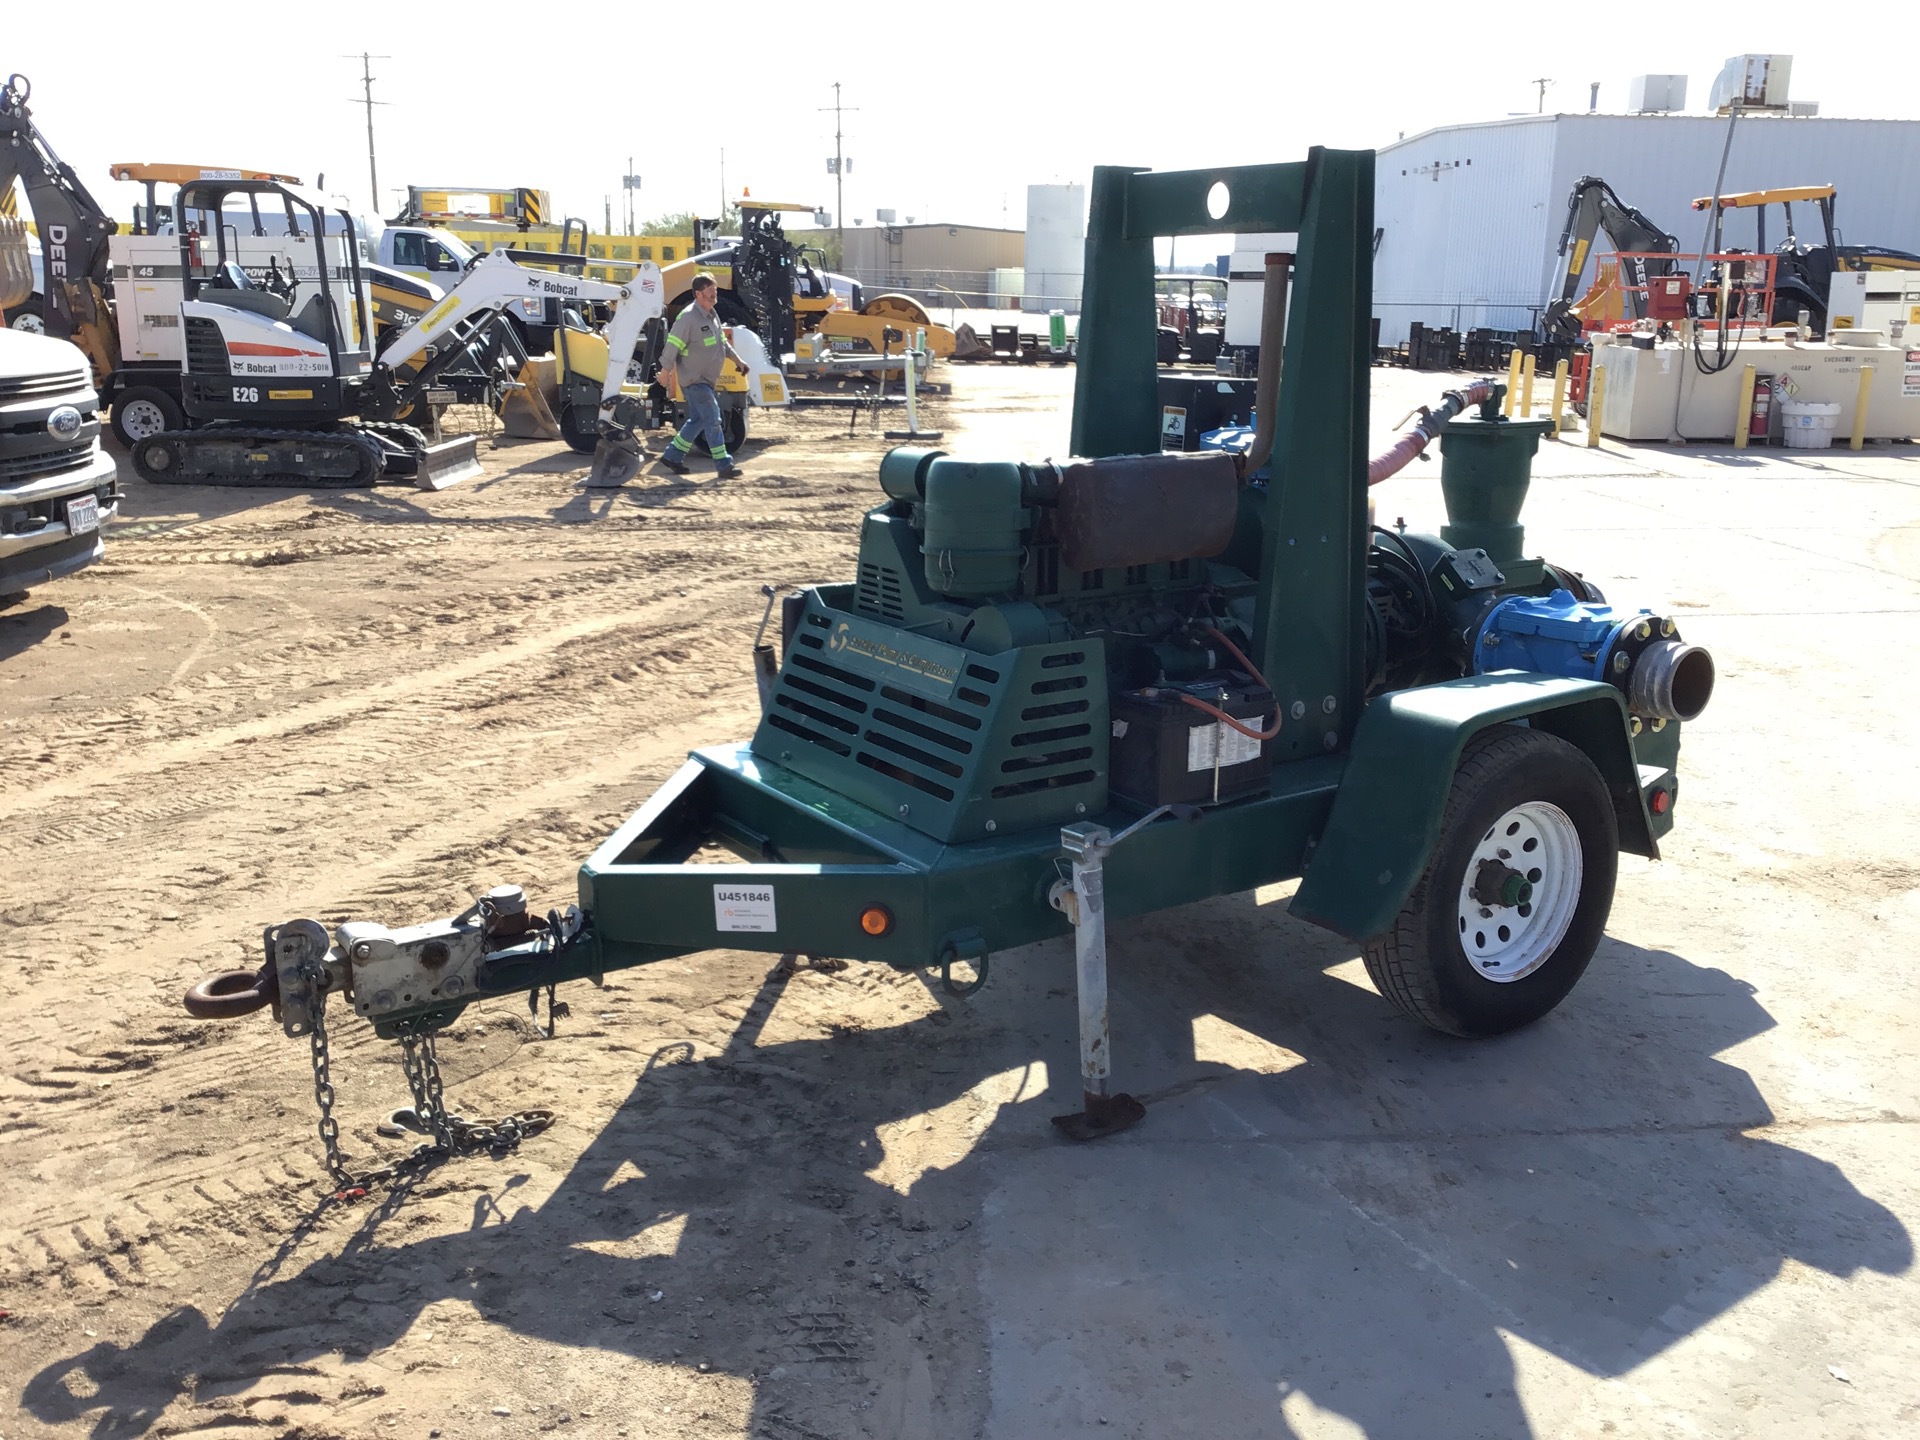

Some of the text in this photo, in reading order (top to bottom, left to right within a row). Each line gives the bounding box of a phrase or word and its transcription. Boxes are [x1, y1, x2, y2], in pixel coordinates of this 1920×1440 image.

[139, 267, 154, 276] 45
[543, 280, 578, 296] Bobcat
[246, 362, 277, 374] Bobcat
[764, 383, 780, 391] Herc
[1781, 376, 1788, 387] 4
[232, 386, 259, 403] E26
[59, 414, 77, 432] Ford
[718, 892, 771, 902] U451846
